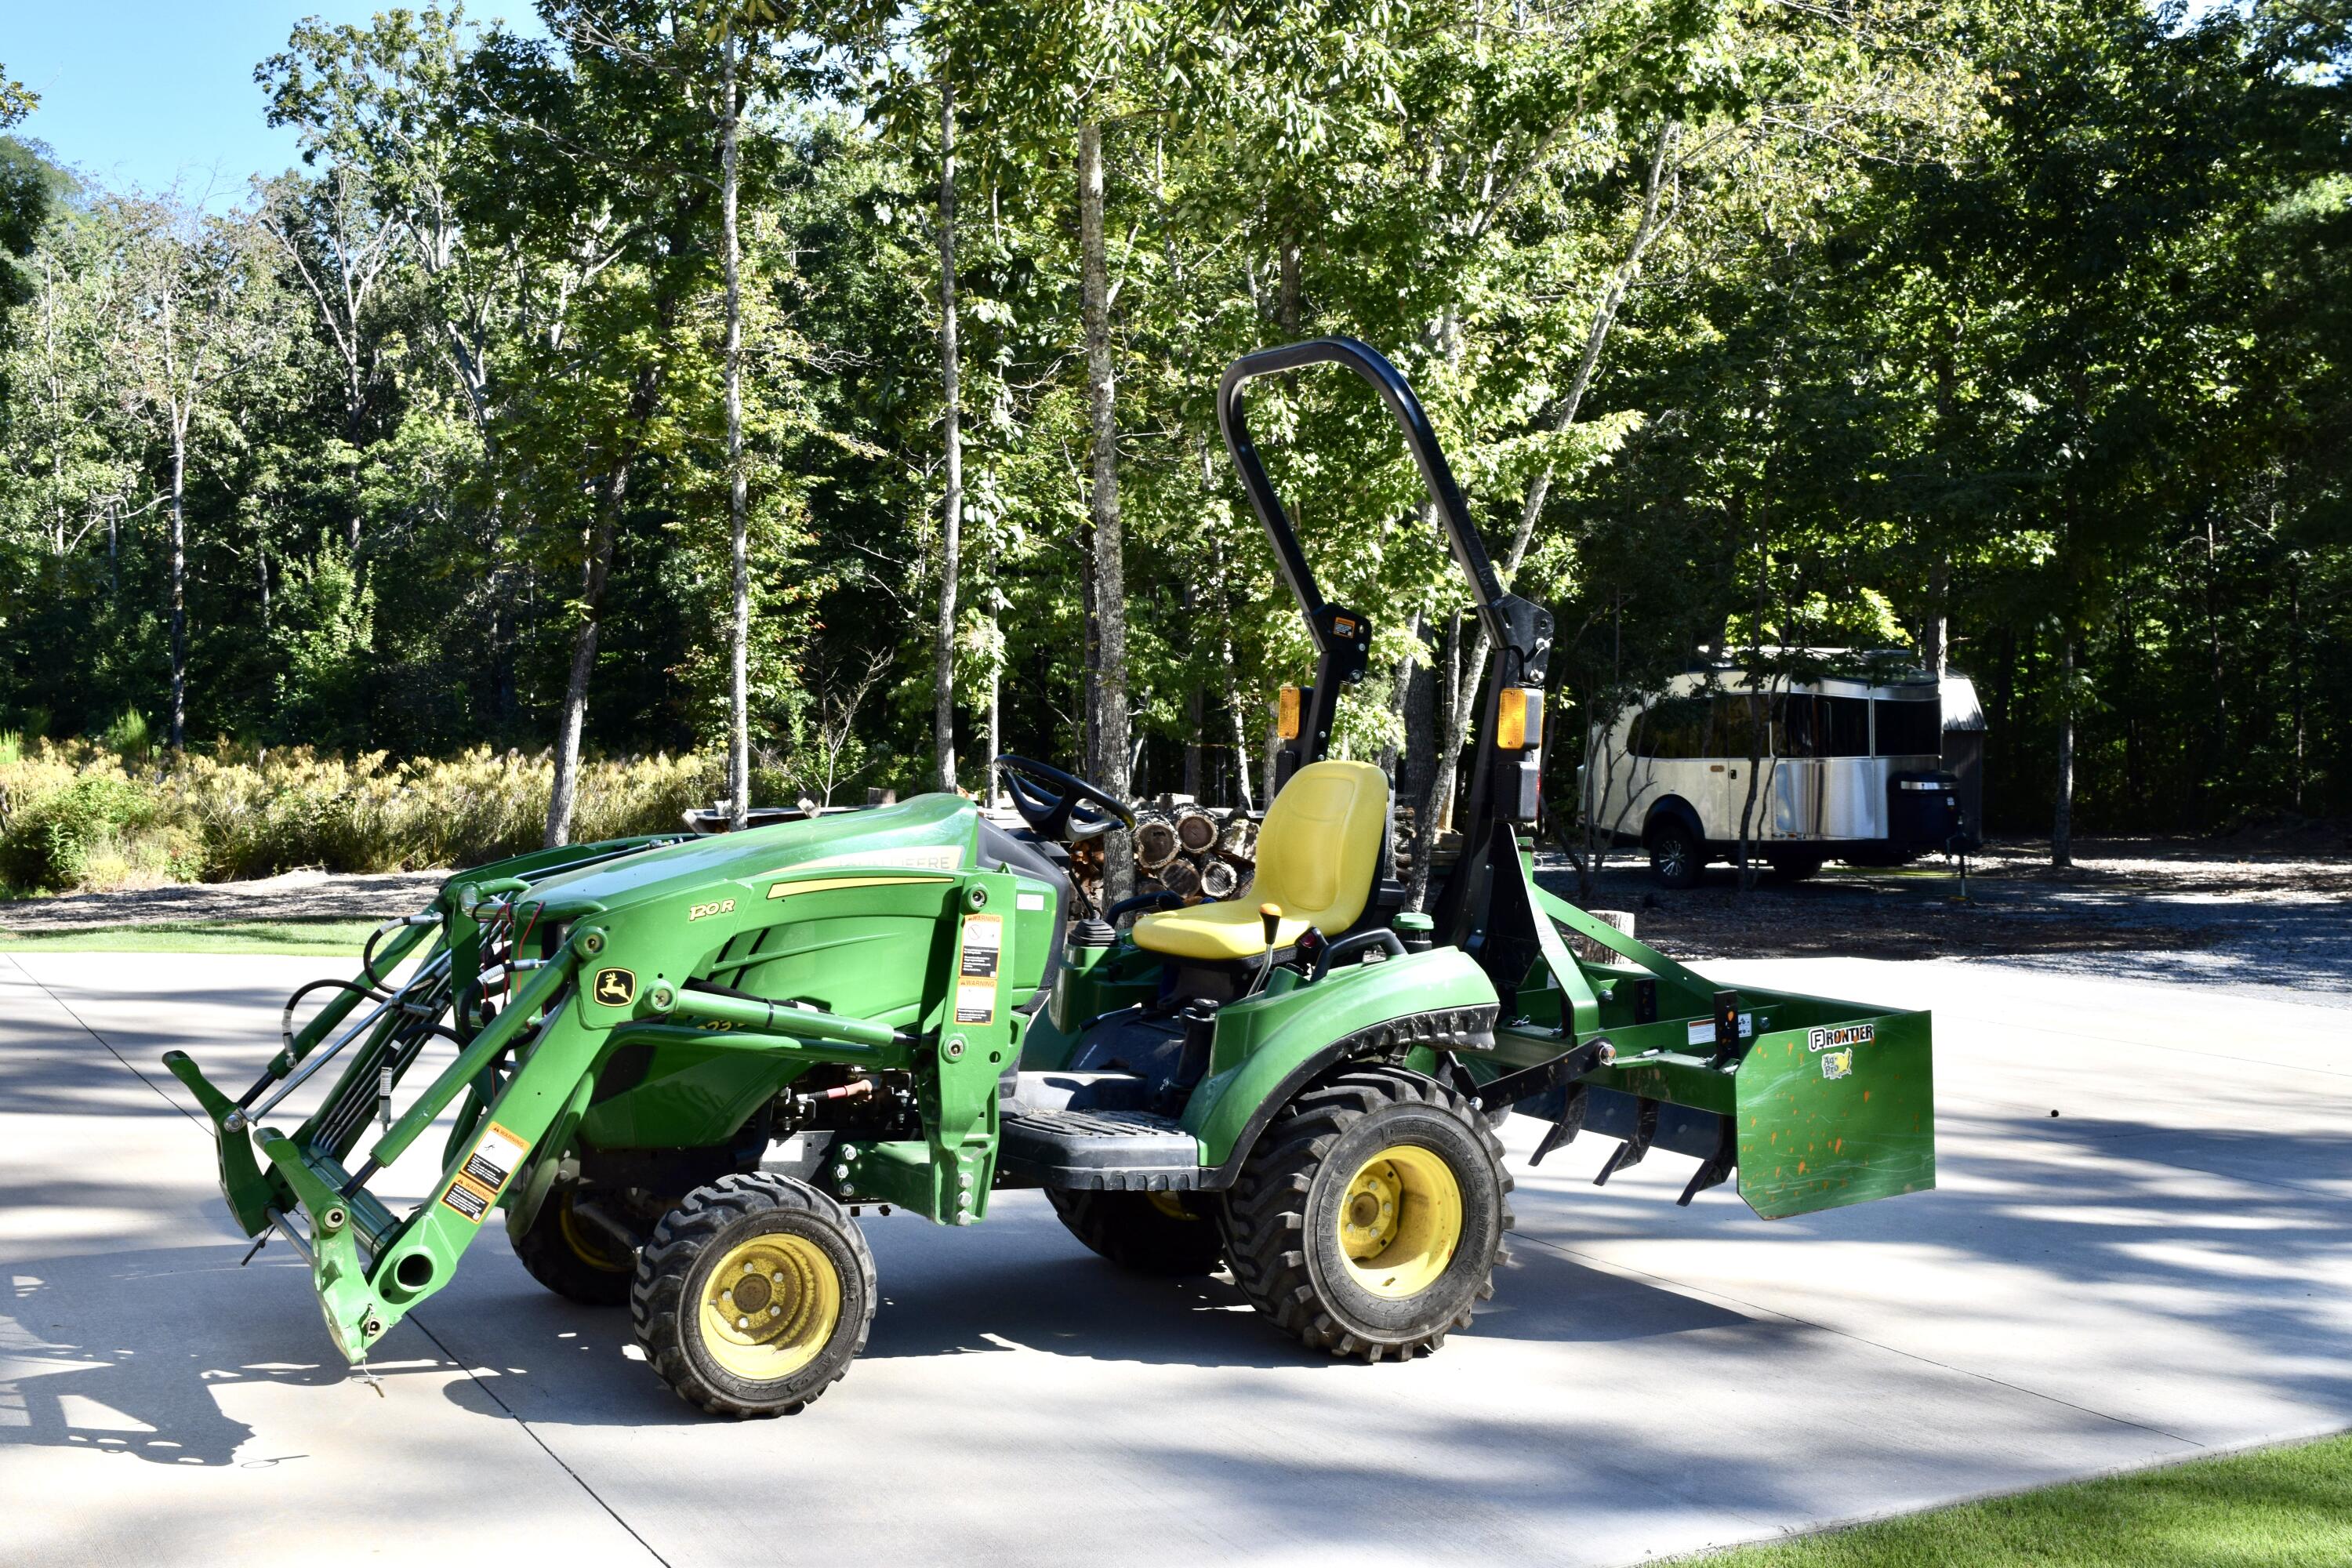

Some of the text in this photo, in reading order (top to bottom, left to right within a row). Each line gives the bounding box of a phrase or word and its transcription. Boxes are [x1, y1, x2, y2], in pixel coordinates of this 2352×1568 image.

[1810, 1025, 1874, 1050] FRONTIER
[1824, 1065, 1839, 1076] Pro
[499, 1129, 524, 1148] WARNING
[466, 1181, 489, 1200] WARNING
